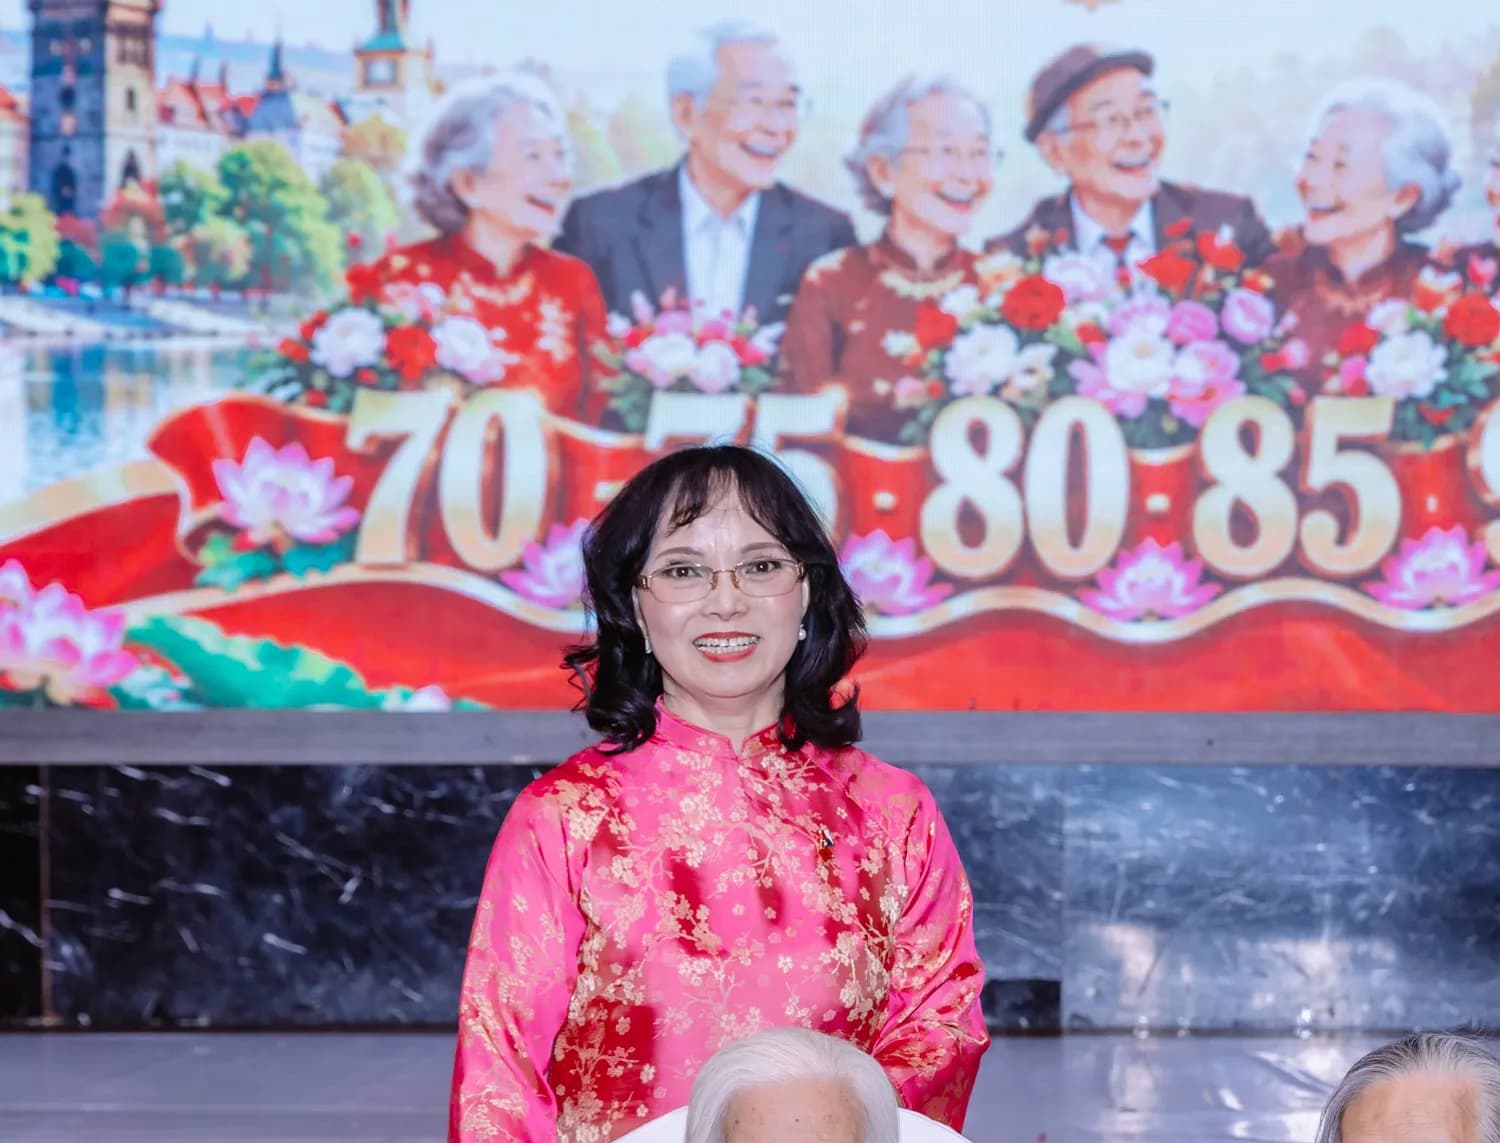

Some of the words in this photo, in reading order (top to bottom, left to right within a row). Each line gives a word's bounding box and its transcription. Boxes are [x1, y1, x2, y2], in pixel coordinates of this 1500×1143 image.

[346, 387, 553, 573] 70
[921, 396, 1130, 579] 80
[1192, 396, 1401, 577] 85
